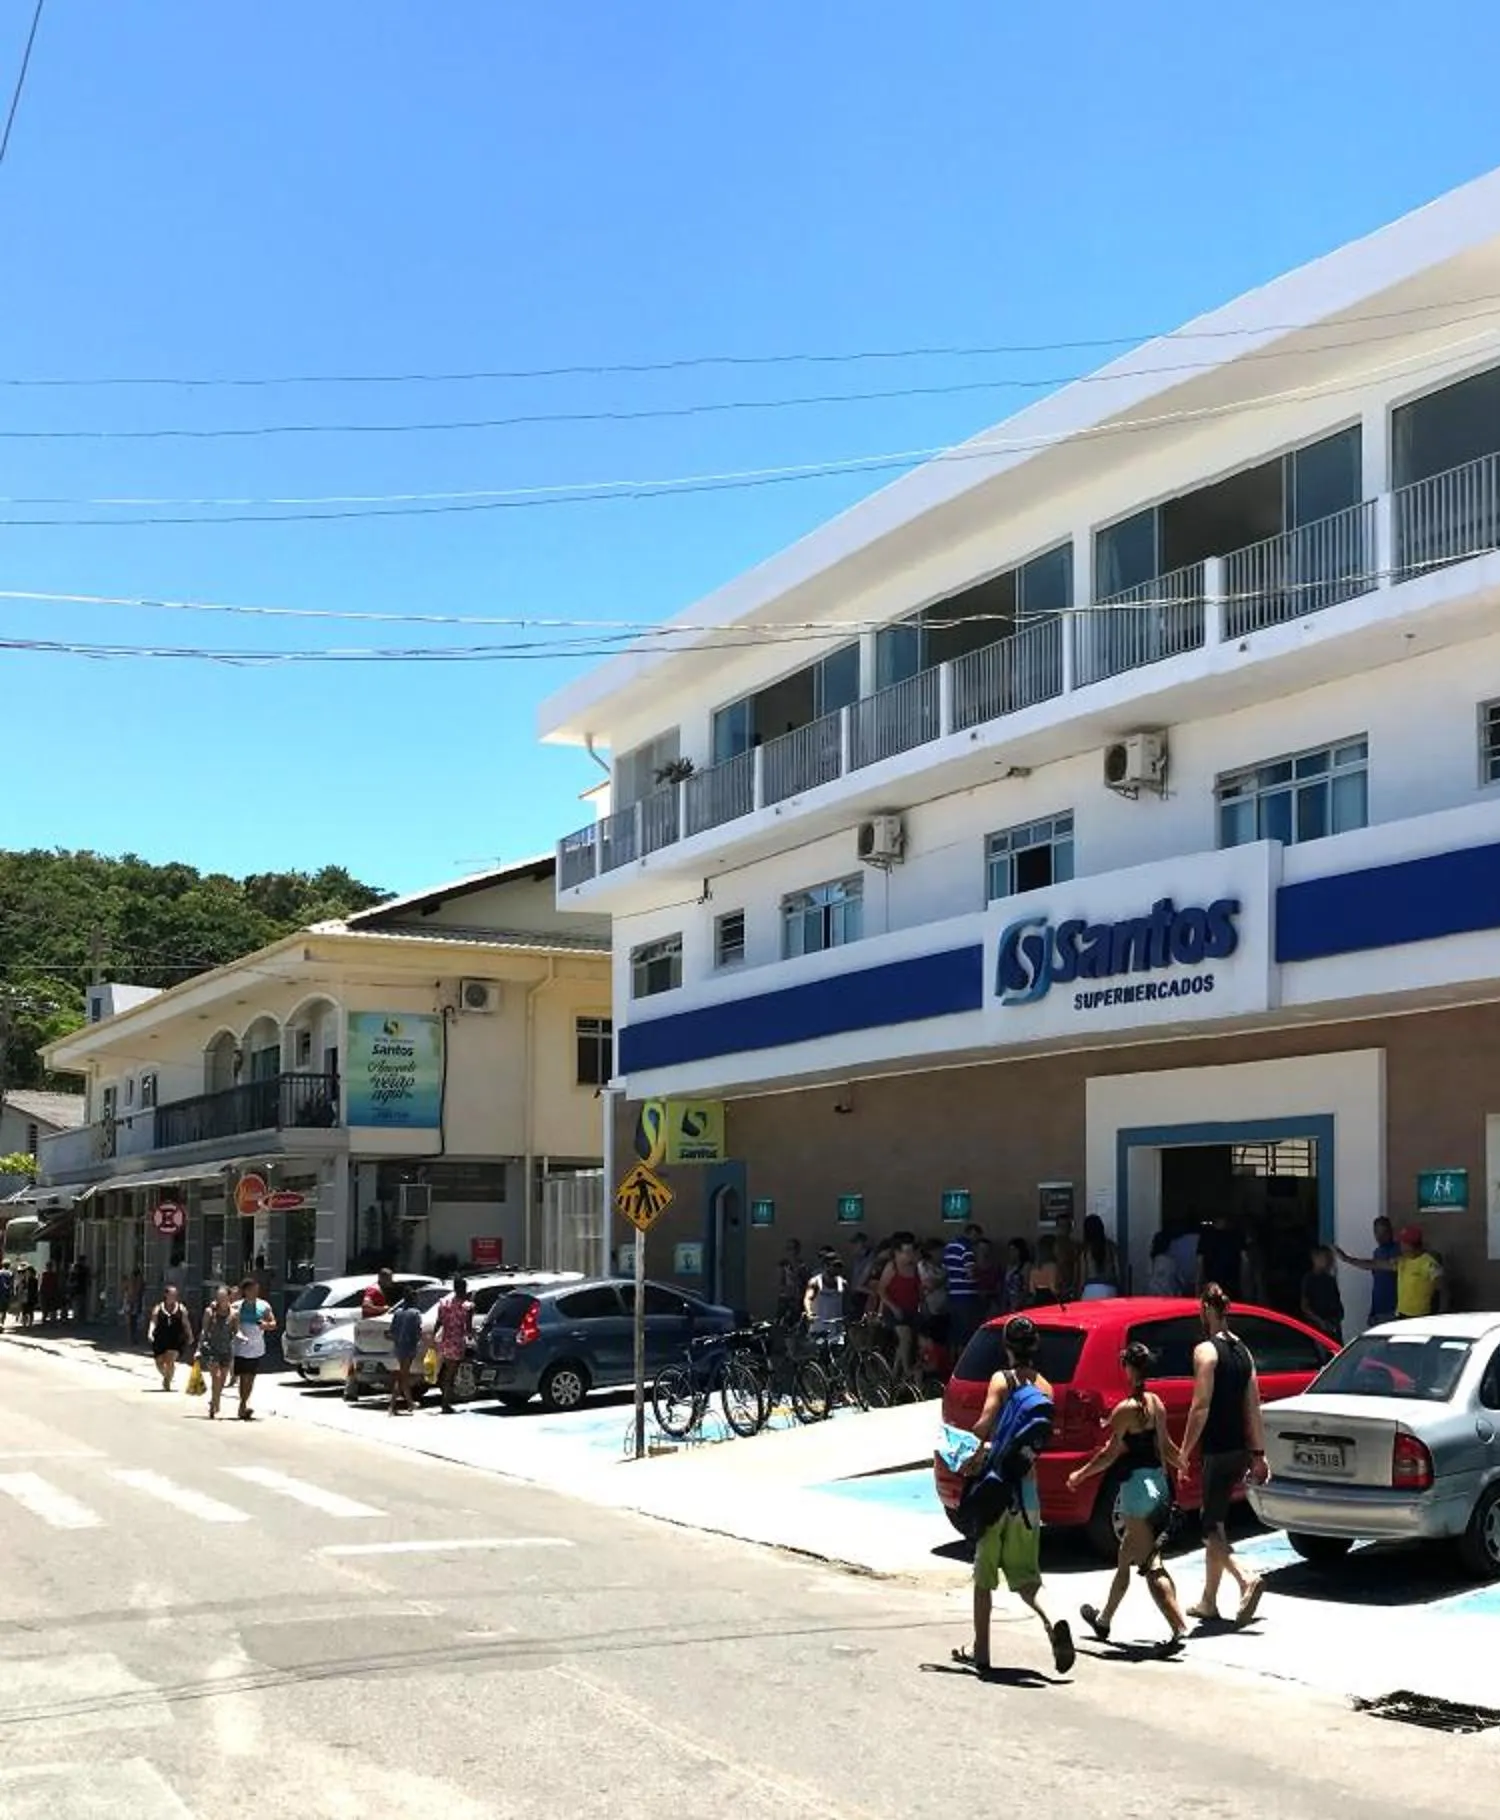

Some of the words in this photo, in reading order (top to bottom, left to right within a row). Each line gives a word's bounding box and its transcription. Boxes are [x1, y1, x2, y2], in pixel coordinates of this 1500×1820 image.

[1051, 897, 1241, 983] Santos
[1073, 974, 1215, 1010] SUPERMERCADOS
[372, 1044, 414, 1056] Santos
